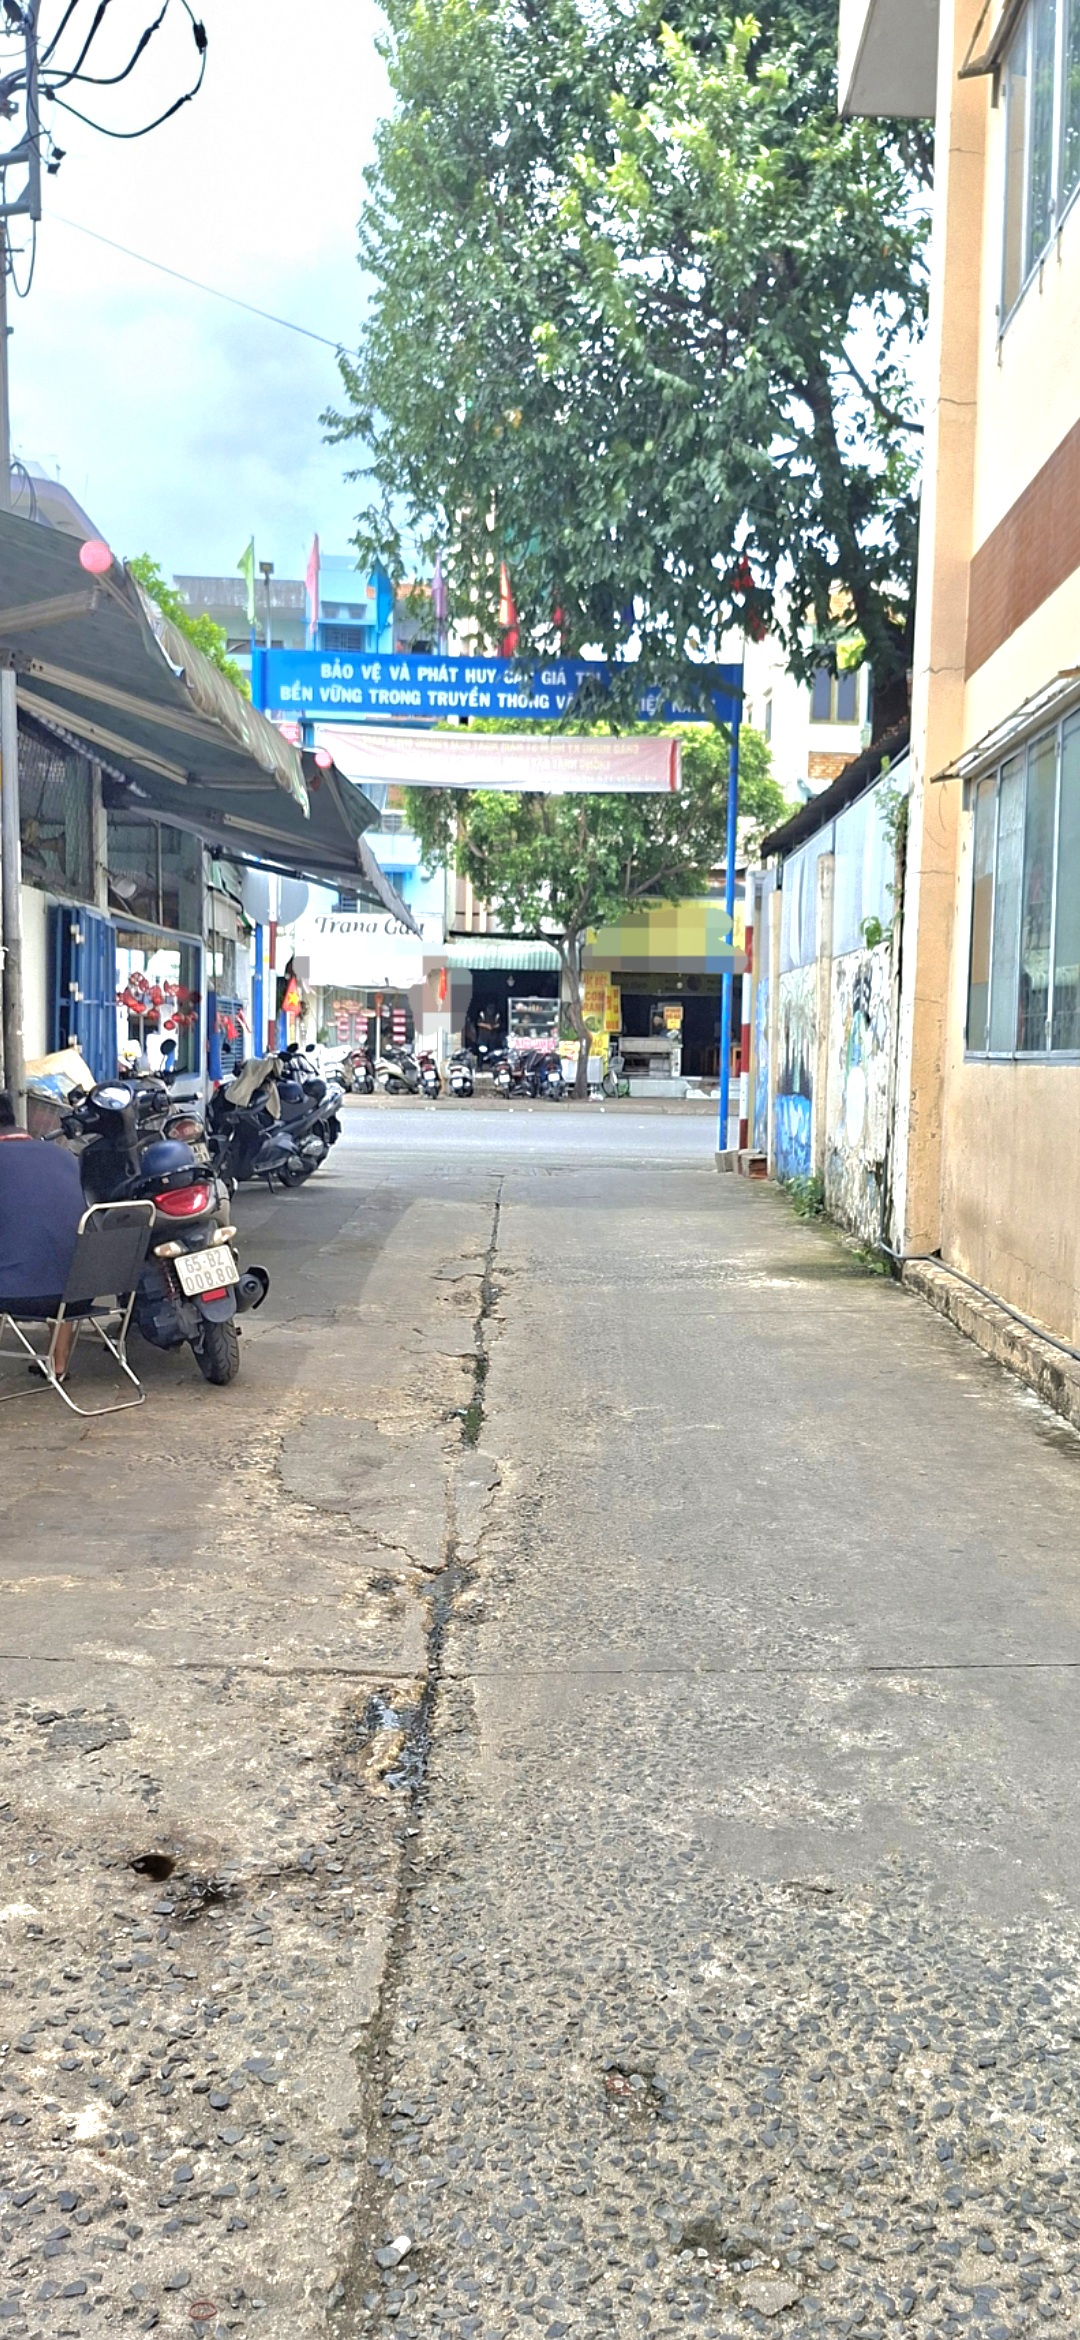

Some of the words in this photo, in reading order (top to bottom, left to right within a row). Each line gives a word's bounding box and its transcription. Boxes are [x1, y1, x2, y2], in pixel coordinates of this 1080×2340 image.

[321, 658, 354, 679] BẢO
[361, 661, 382, 684] VỆ
[389, 661, 410, 681] VÀ
[417, 664, 459, 683] PHÁT
[465, 668, 497, 684] HUY
[541, 667, 567, 686] GIÁ
[319, 683, 363, 703] VỮNG
[369, 688, 421, 705] TRONG
